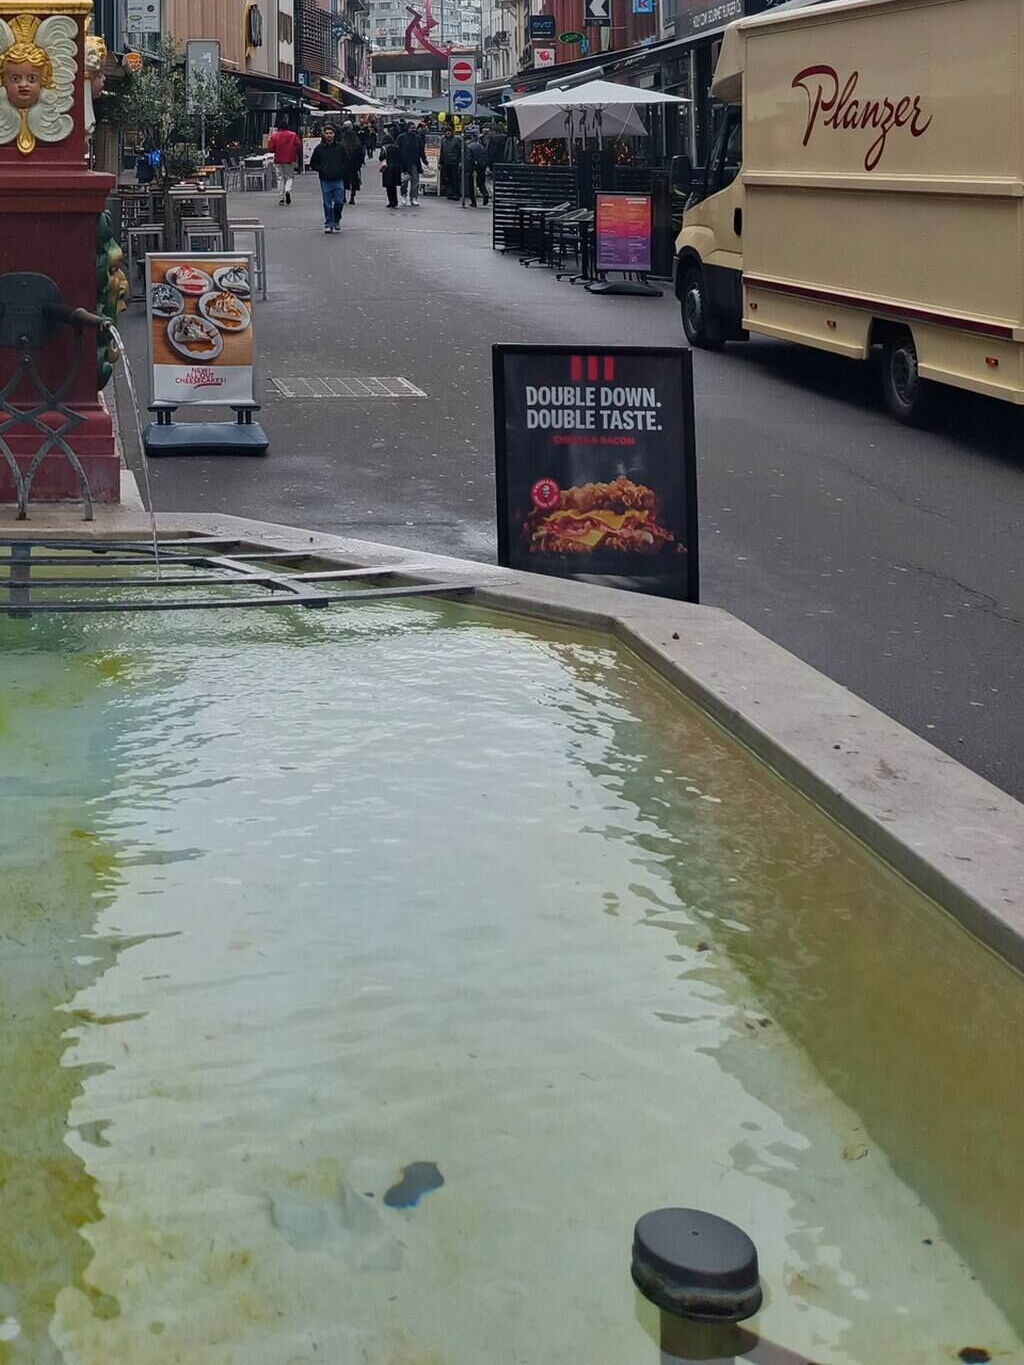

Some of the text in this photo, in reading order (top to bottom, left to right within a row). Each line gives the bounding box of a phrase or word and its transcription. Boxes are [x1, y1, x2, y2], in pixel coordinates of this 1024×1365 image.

[792, 65, 933, 171] Planzer
[526, 386, 662, 408] DOUBLE DOWN.
[527, 409, 663, 431] DOUBLE TASTE.
